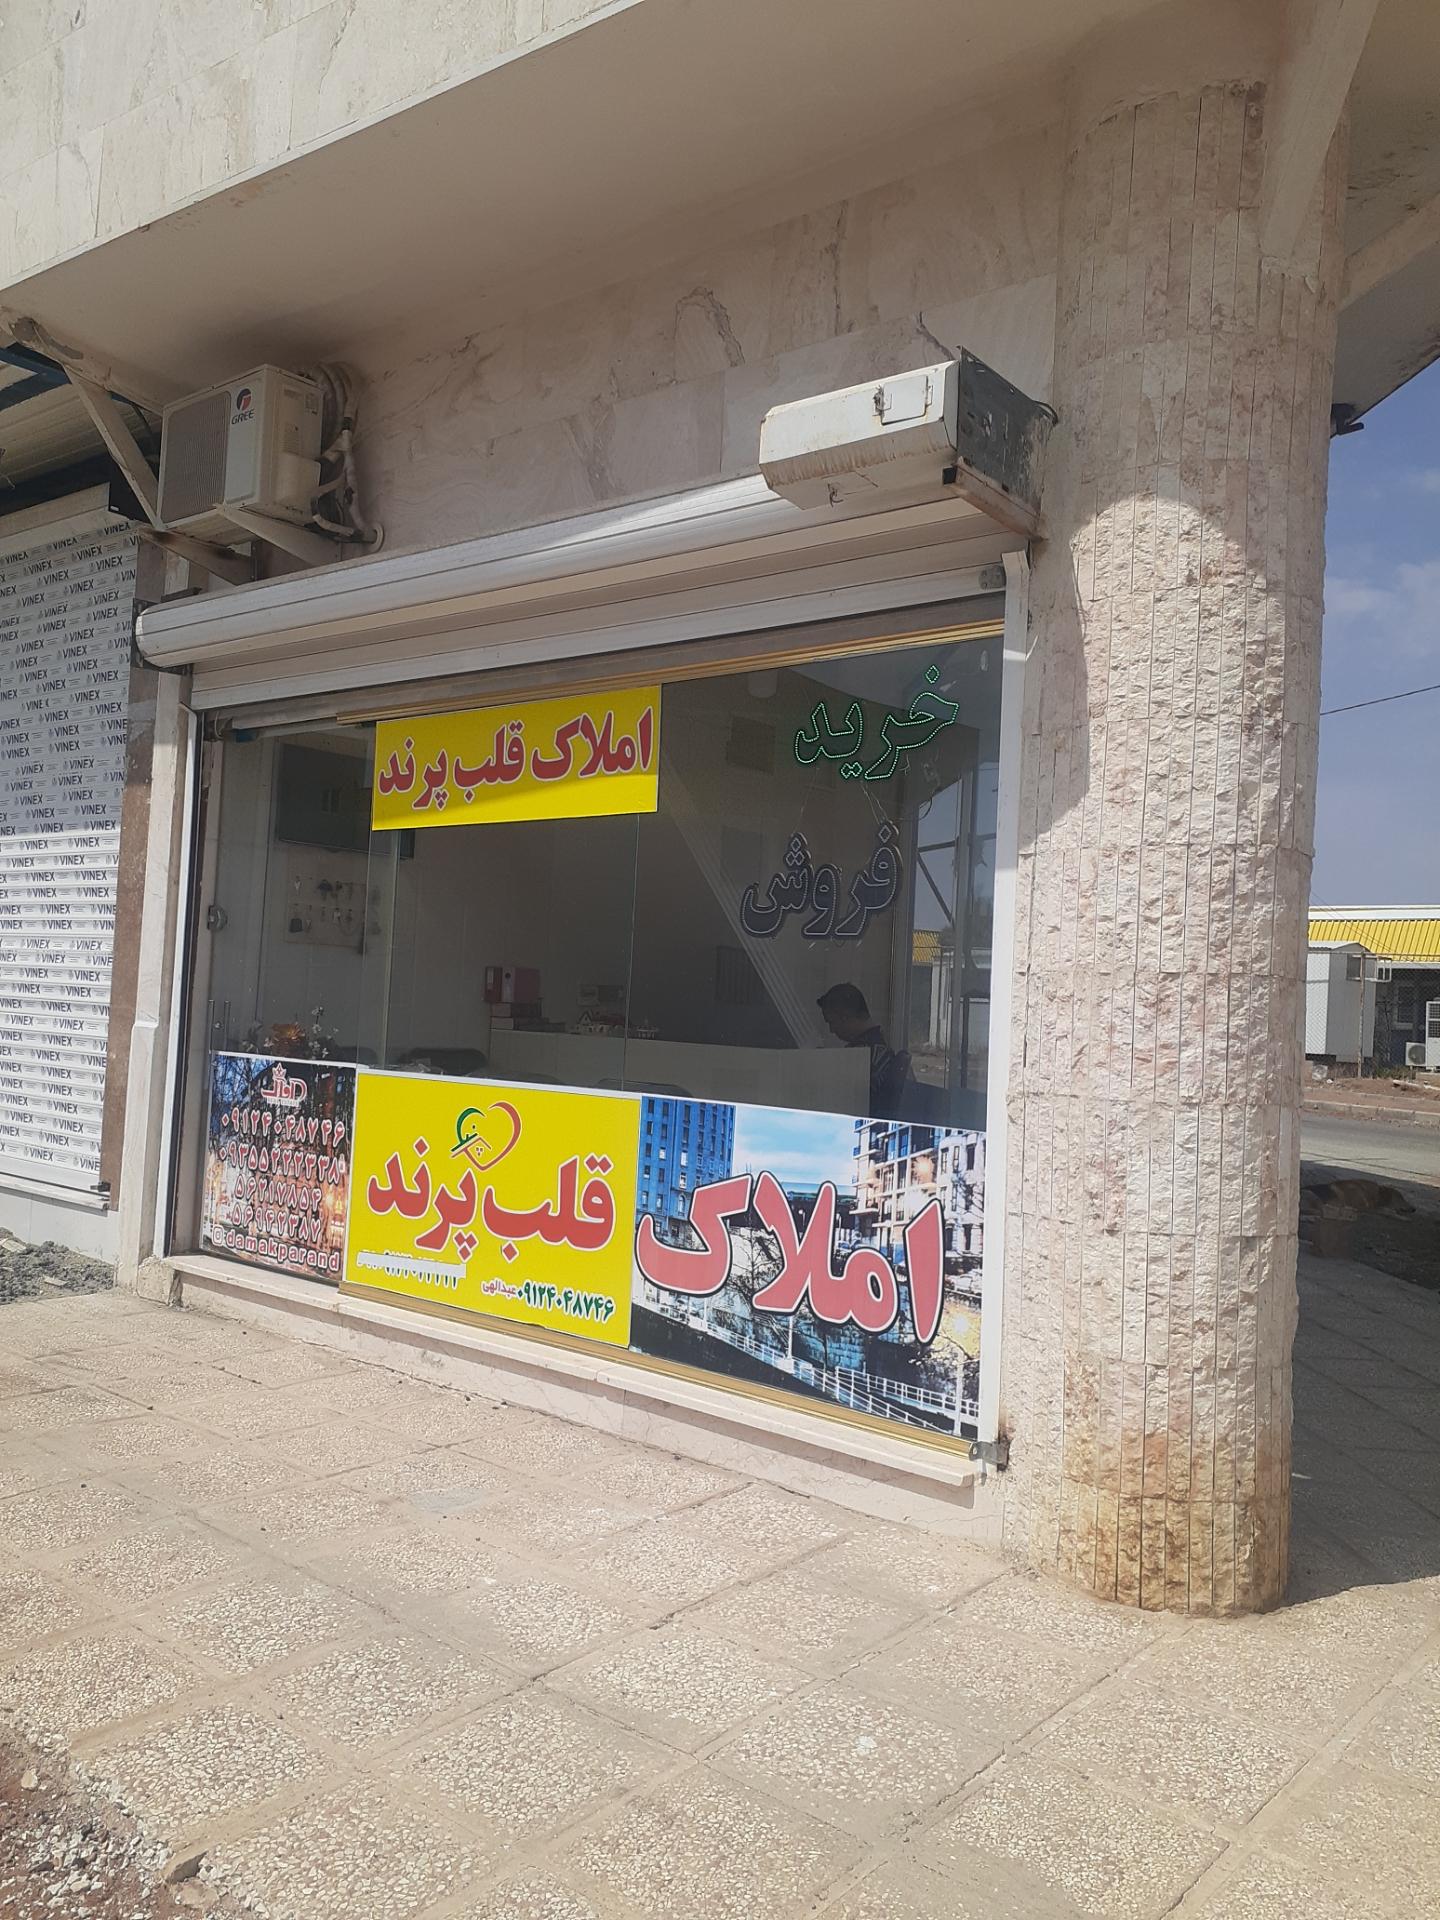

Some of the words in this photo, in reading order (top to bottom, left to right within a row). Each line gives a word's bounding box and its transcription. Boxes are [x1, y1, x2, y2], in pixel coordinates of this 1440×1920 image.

[231, 408, 255, 425] GREE
[28, 559, 52, 575] VINEX
[76, 545, 103, 560] VINEX
[43, 569, 69, 585] VINEX
[96, 555, 123, 571] VINEX
[22, 592, 45, 607] VINEX
[69, 579, 94, 594] VINEX
[44, 604, 68, 618] VINEX
[94, 590, 120, 605] VINEX
[43, 619, 66, 633] VINEX
[92, 607, 118, 621] VINEX
[21, 639, 44, 653] VINEX
[69, 628, 94, 643] VINEX
[15, 656, 38, 669] VINEX
[63, 645, 87, 659] VINEX
[25, 669, 48, 682] VINEX
[73, 658, 98, 672] VINEX
[42, 679, 66, 693] VINEX
[92, 670, 119, 683] VINEX
[75, 689, 100, 703] VINEX
[45, 709, 69, 722] VINEX
[96, 701, 122, 715] VINEX
[794, 664, 960, 781] خرید
[6, 732, 30, 744] VINEX
[54, 725, 80, 737] VINEX
[531, 706, 654, 780] املاک
[6, 747, 30, 759] VINEX
[54, 740, 80, 753] VINEX
[21, 764, 44, 776] VINEX
[69, 758, 94, 770] VINEX
[452, 719, 526, 804] قلب
[10, 780, 33, 792] VINEX
[58, 775, 83, 787] VINEX
[377, 737, 450, 812] پرند
[20, 793, 43, 806] VINEX
[68, 789, 93, 802] VINEX
[31, 807, 55, 819] VINEX
[81, 803, 107, 816] VINEX
[40, 822, 64, 834] VINEX
[90, 819, 117, 831] VINEX
[24, 839, 49, 850] VINEX
[74, 836, 100, 848] VINEX
[11, 857, 35, 869] VINEX
[60, 854, 85, 866] VINEX
[31, 872, 55, 882] VINEX
[81, 870, 107, 882] VINEX
[740, 822, 901, 938] فروش
[32, 887, 57, 898] VINEX
[83, 887, 110, 898] VINEX
[46, 903, 71, 914] VINEX
[47, 920, 72, 931] VINEX
[26, 939, 50, 950] VINEX
[76, 940, 103, 952] VINEX
[41, 953, 66, 965] VINEX
[24, 967, 49, 979] VINEX
[74, 969, 100, 982] VINEX
[17, 983, 41, 994] VINEX
[66, 985, 91, 998] VINEX
[46, 1001, 72, 1013] VINEX
[11, 1015, 34, 1026] VINEX
[59, 1018, 85, 1031] VINEX
[47, 1034, 73, 1047] VINEX
[36, 1049, 60, 1062] VINEX
[46, 1066, 72, 1080] VINEX
[1, 1077, 23, 1089] VINEX
[48, 1083, 73, 1097] VINEX
[5, 1094, 29, 1107] VINEX
[53, 1100, 79, 1115] VINEX
[10, 1110, 34, 1124] VINEX
[58, 1118, 85, 1134] VINEX
[221, 1107, 345, 1148] ۰۹۱۲۴۰۴۸۷۴۶
[44, 1131, 70, 1147] VINEX
[29, 1147, 54, 1162] VINEX
[366, 1135, 479, 1263] پرند
[482, 1153, 617, 1264] قلب
[635, 1170, 946, 1345] املاک
[481, 1277, 518, 1299] عبدالهی
[517, 1279, 616, 1322] ۰۹۱۲۴۰۴۸۷۴۶
